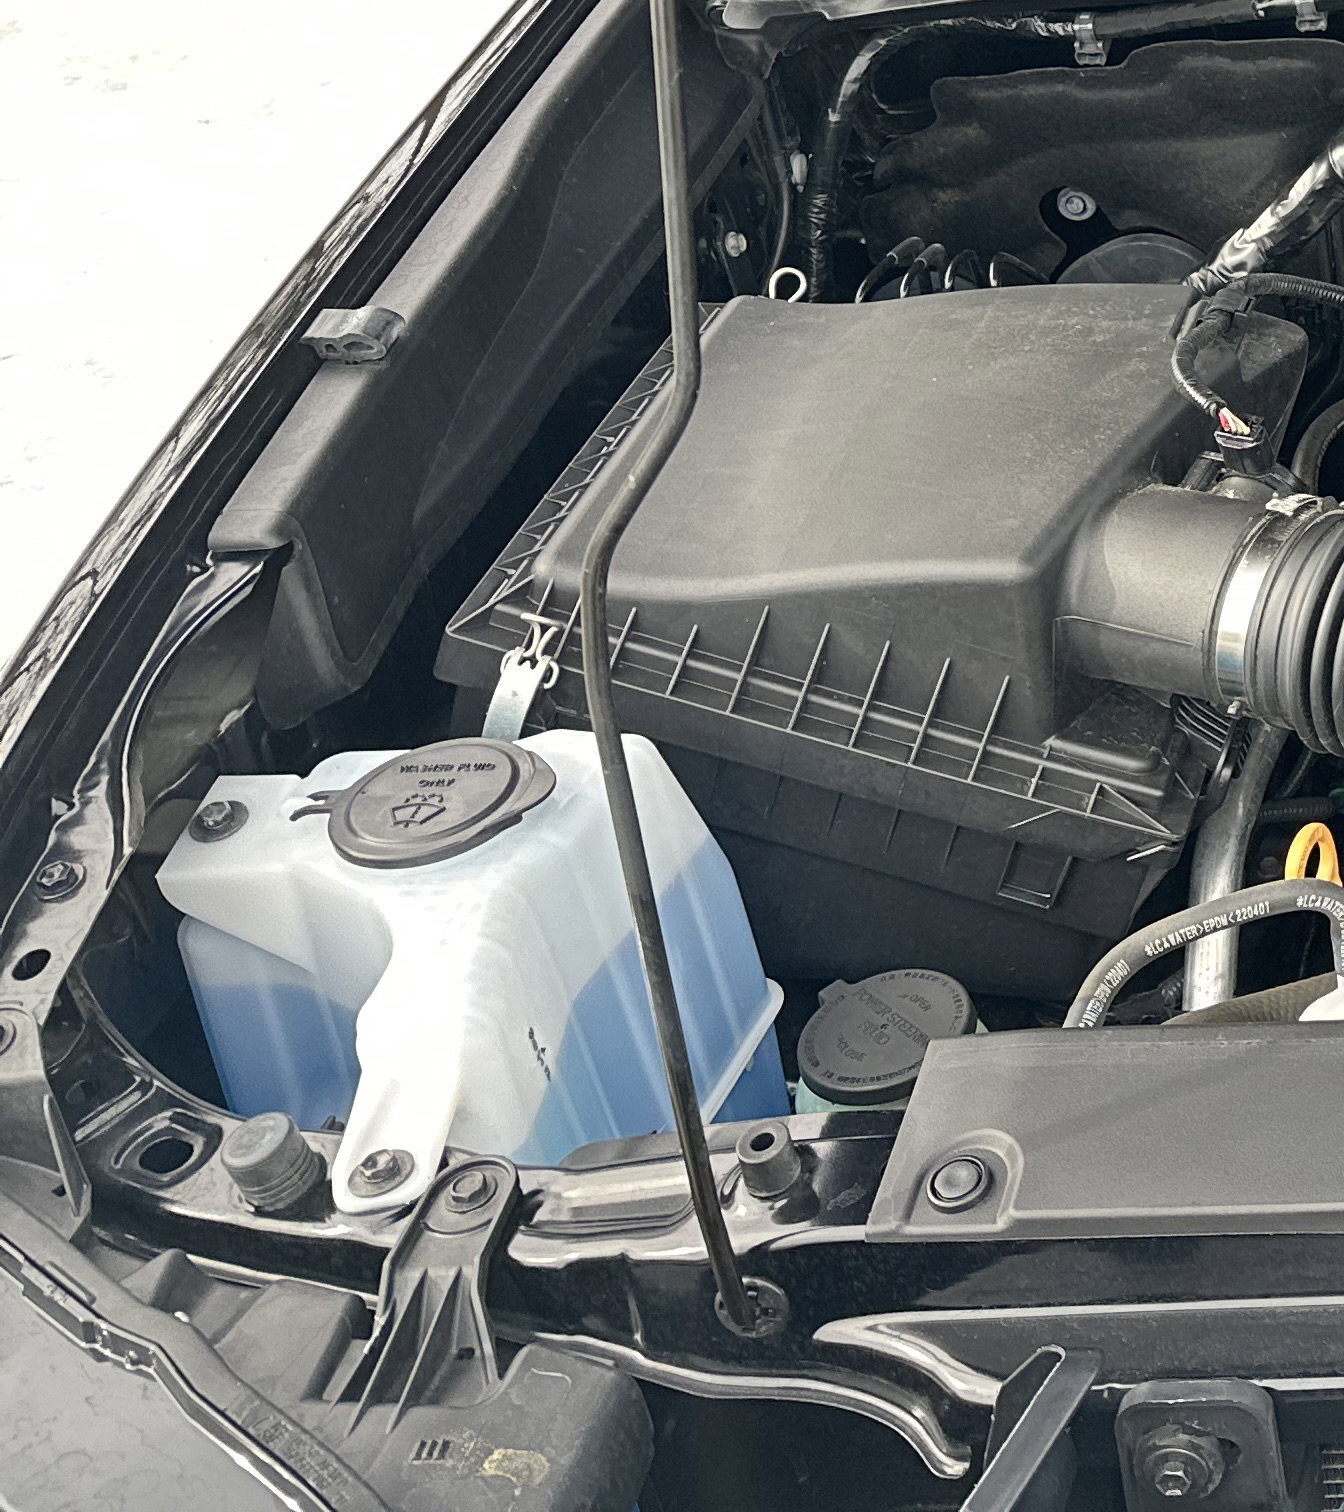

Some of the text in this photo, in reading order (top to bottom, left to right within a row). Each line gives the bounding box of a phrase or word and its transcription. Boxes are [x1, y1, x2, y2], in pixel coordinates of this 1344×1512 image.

[852, 988, 930, 1048] POWER STEERIN
[909, 993, 932, 1012] OPEN
